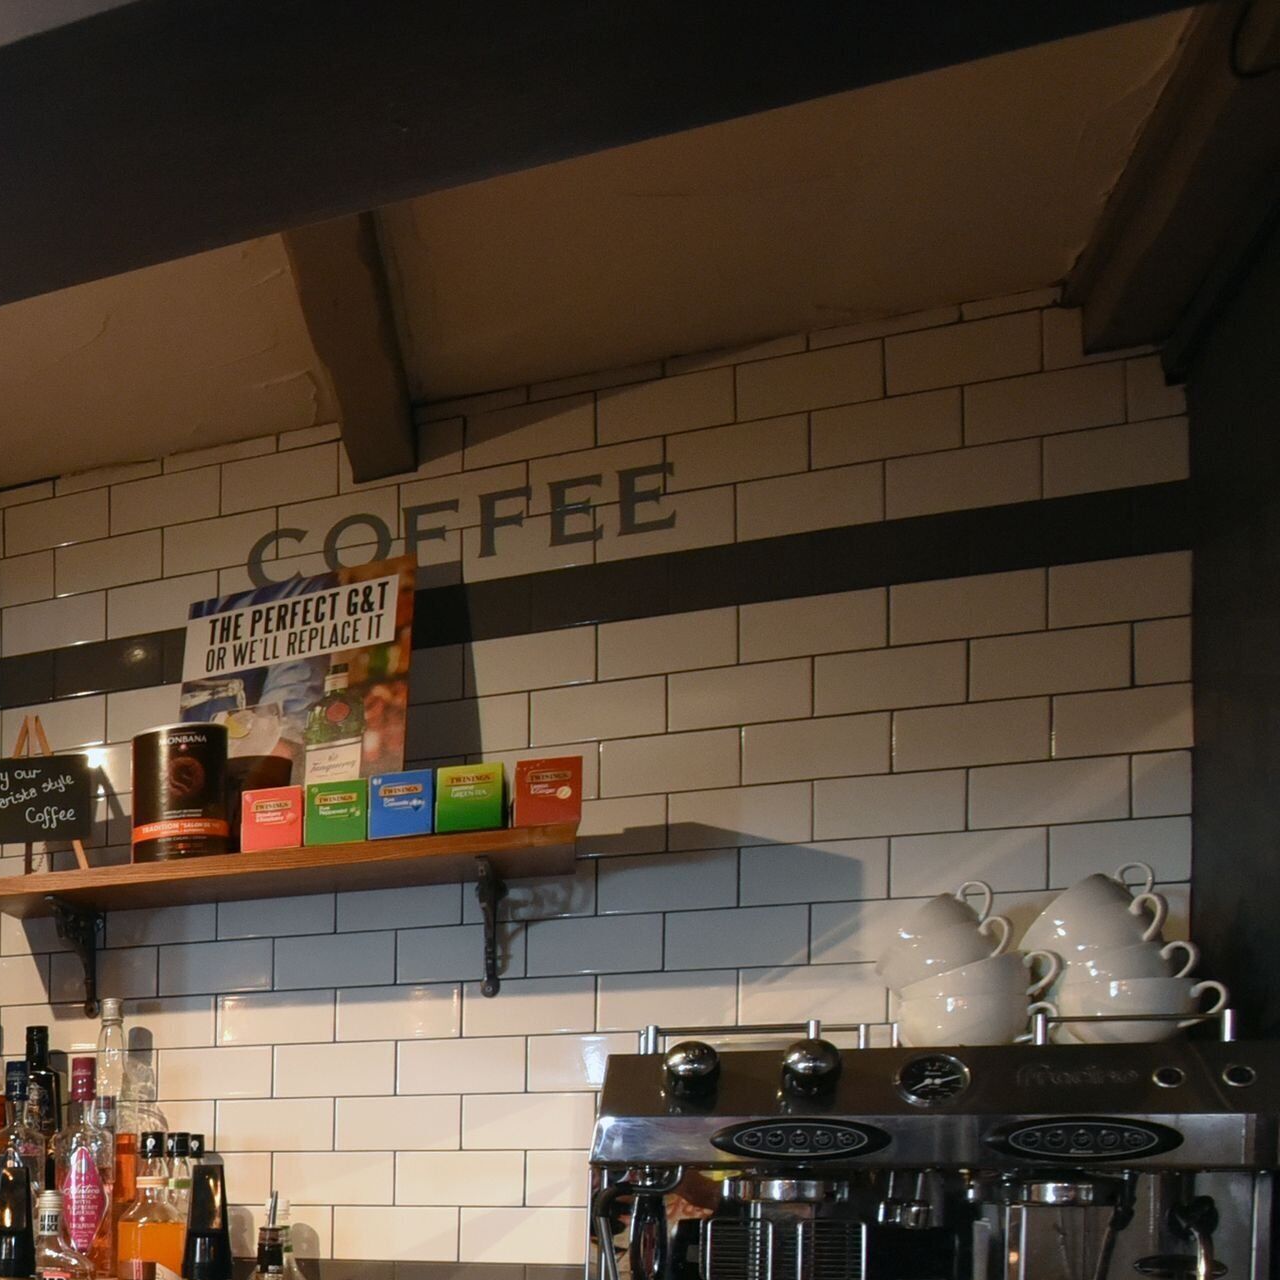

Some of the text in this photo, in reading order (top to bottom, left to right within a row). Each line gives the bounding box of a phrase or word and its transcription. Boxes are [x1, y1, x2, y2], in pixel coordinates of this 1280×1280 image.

[247, 461, 678, 588] COFFEE
[209, 581, 389, 646] THE PERFECT G&T
[205, 613, 384, 674] OR WE'LL REPLACE IT
[160, 733, 208, 746] MONBANA
[310, 758, 356, 774] Tanqueray
[14, 769, 42, 780] our
[449, 774, 492, 784] TWININGS
[529, 772, 570, 782] TWININGS
[42, 774, 75, 793] style
[383, 784, 420, 795] TWININGS
[318, 793, 356, 804] TWININGS
[255, 802, 290, 811] TWININGS
[25, 806, 77, 829] Coffee
[142, 822, 180, 833] TRADITION
